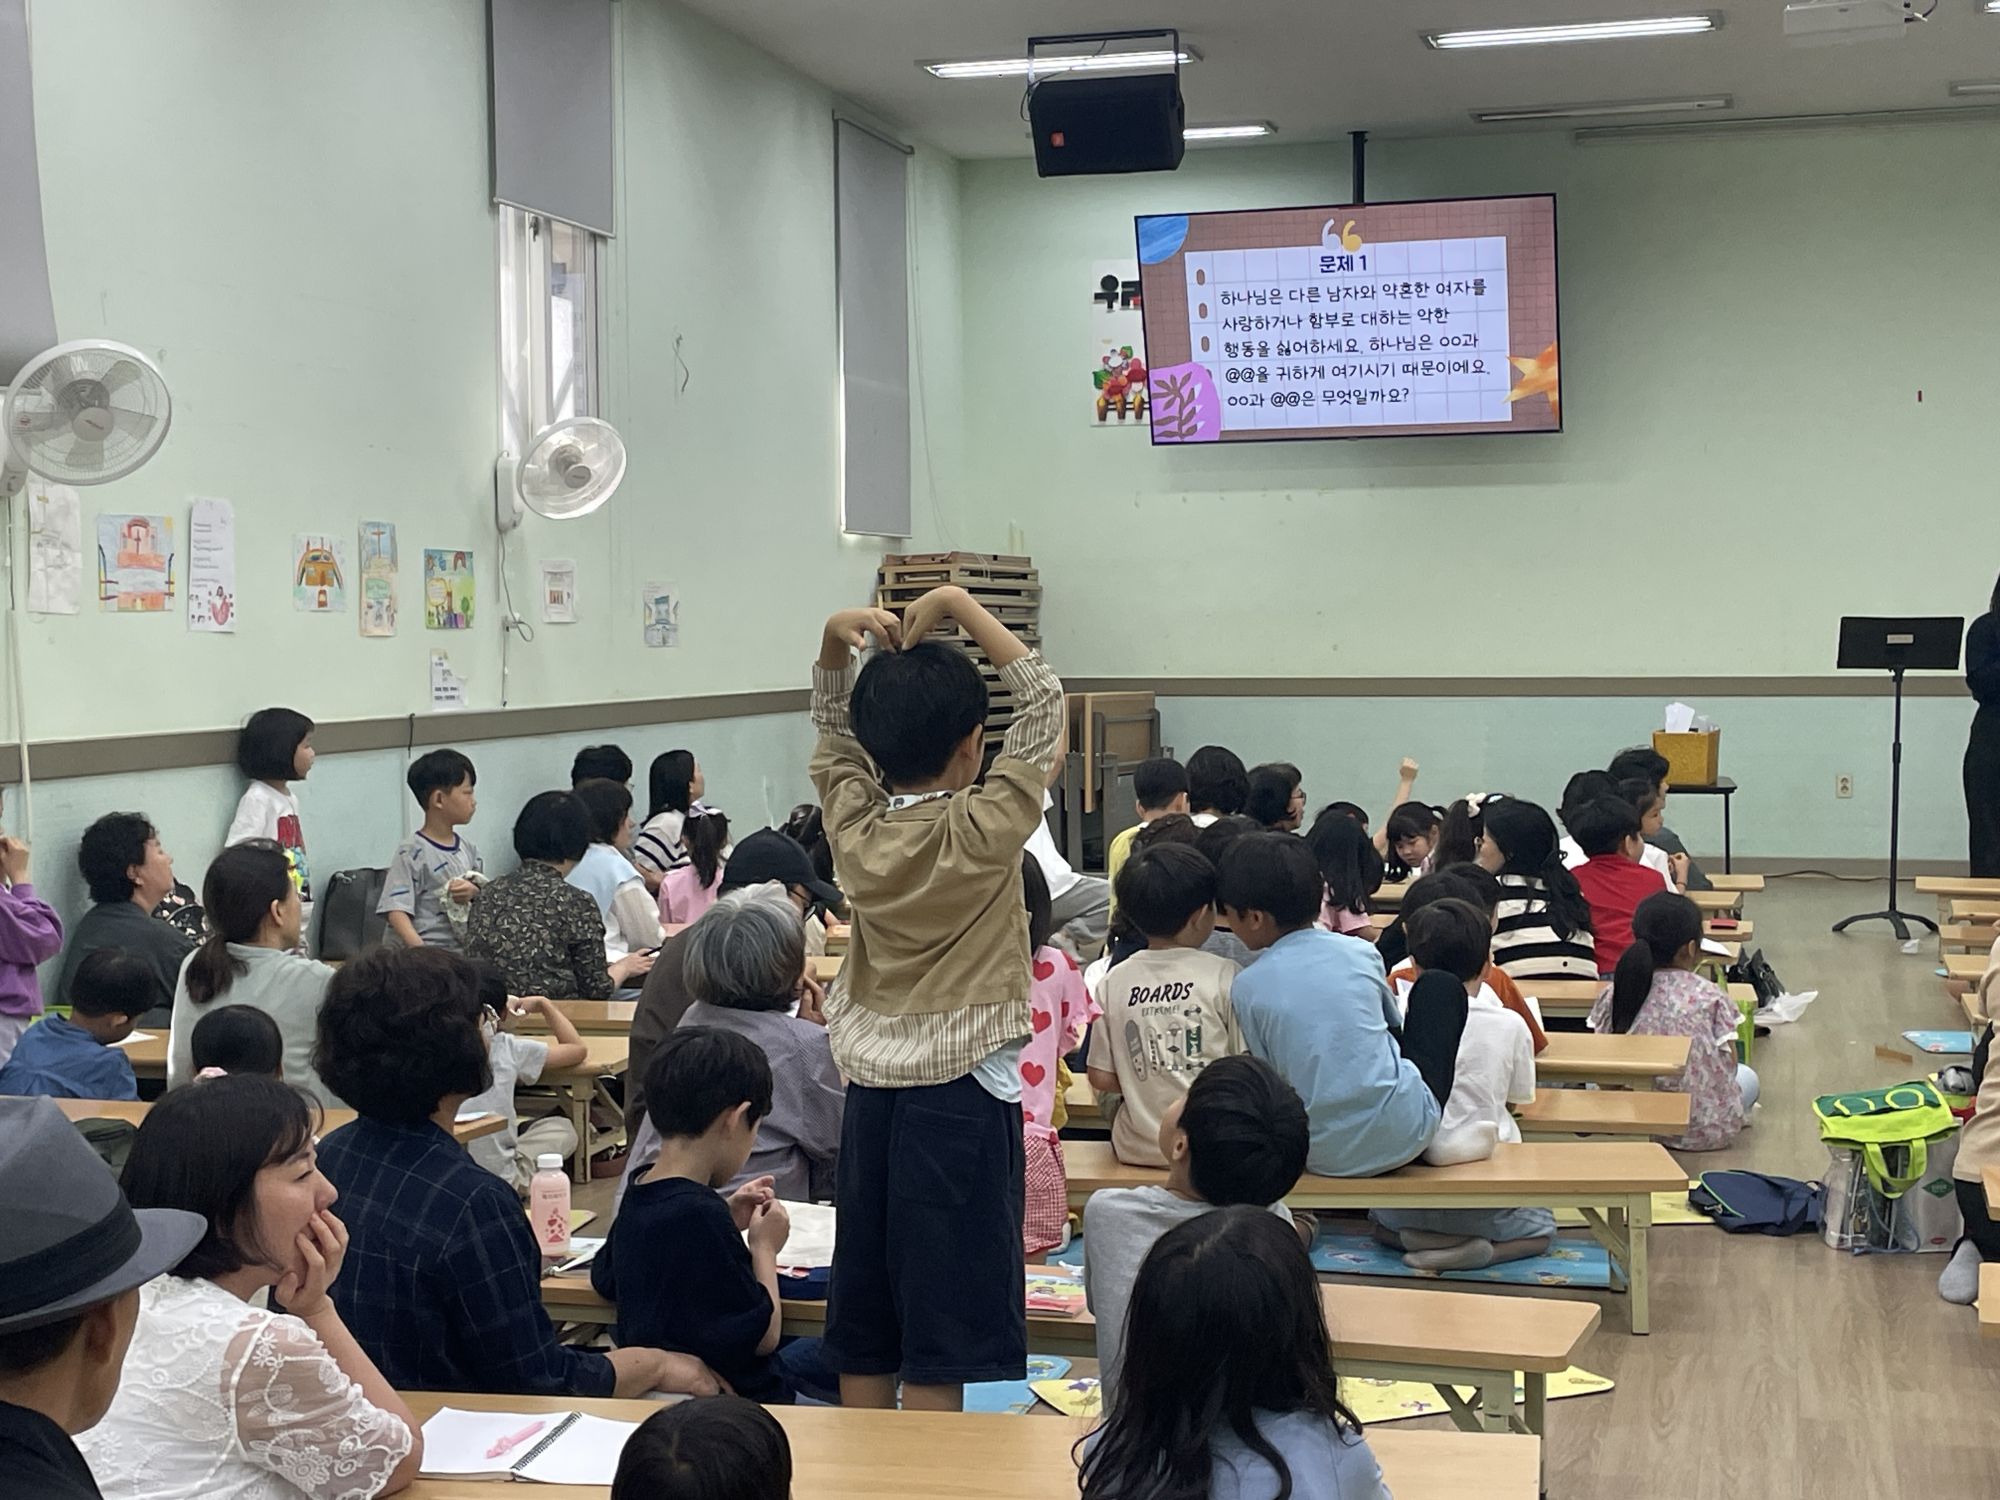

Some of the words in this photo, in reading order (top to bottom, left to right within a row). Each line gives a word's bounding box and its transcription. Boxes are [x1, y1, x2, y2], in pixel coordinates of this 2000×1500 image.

[1319, 254, 1354, 273] 문제
[1359, 254, 1367, 272] 1
[1220, 288, 1283, 306] 하나님은
[1289, 287, 1321, 303] 다른
[1327, 284, 1376, 303] 남자와
[1382, 281, 1430, 300] 약혼한
[1436, 278, 1487, 296] 여자를
[1222, 314, 1303, 332] 사랑하거나
[1309, 311, 1355, 330] 함부로
[1361, 309, 1412, 326] 대하는
[1417, 307, 1450, 325] 악한
[1224, 340, 1270, 358] 행동을
[1276, 337, 1363, 357] 싫어하세요.
[1369, 334, 1434, 352] 하나님은
[1225, 365, 1270, 384] @@을
[1276, 364, 1325, 381] 귀하게
[1332, 361, 1395, 379] 여기시기
[1402, 359, 1490, 377] 때문이에요.
[1271, 390, 1316, 408] @@은
[1322, 387, 1409, 406] 무엇일까요?
[1128, 982, 1194, 1007] BOARDS
